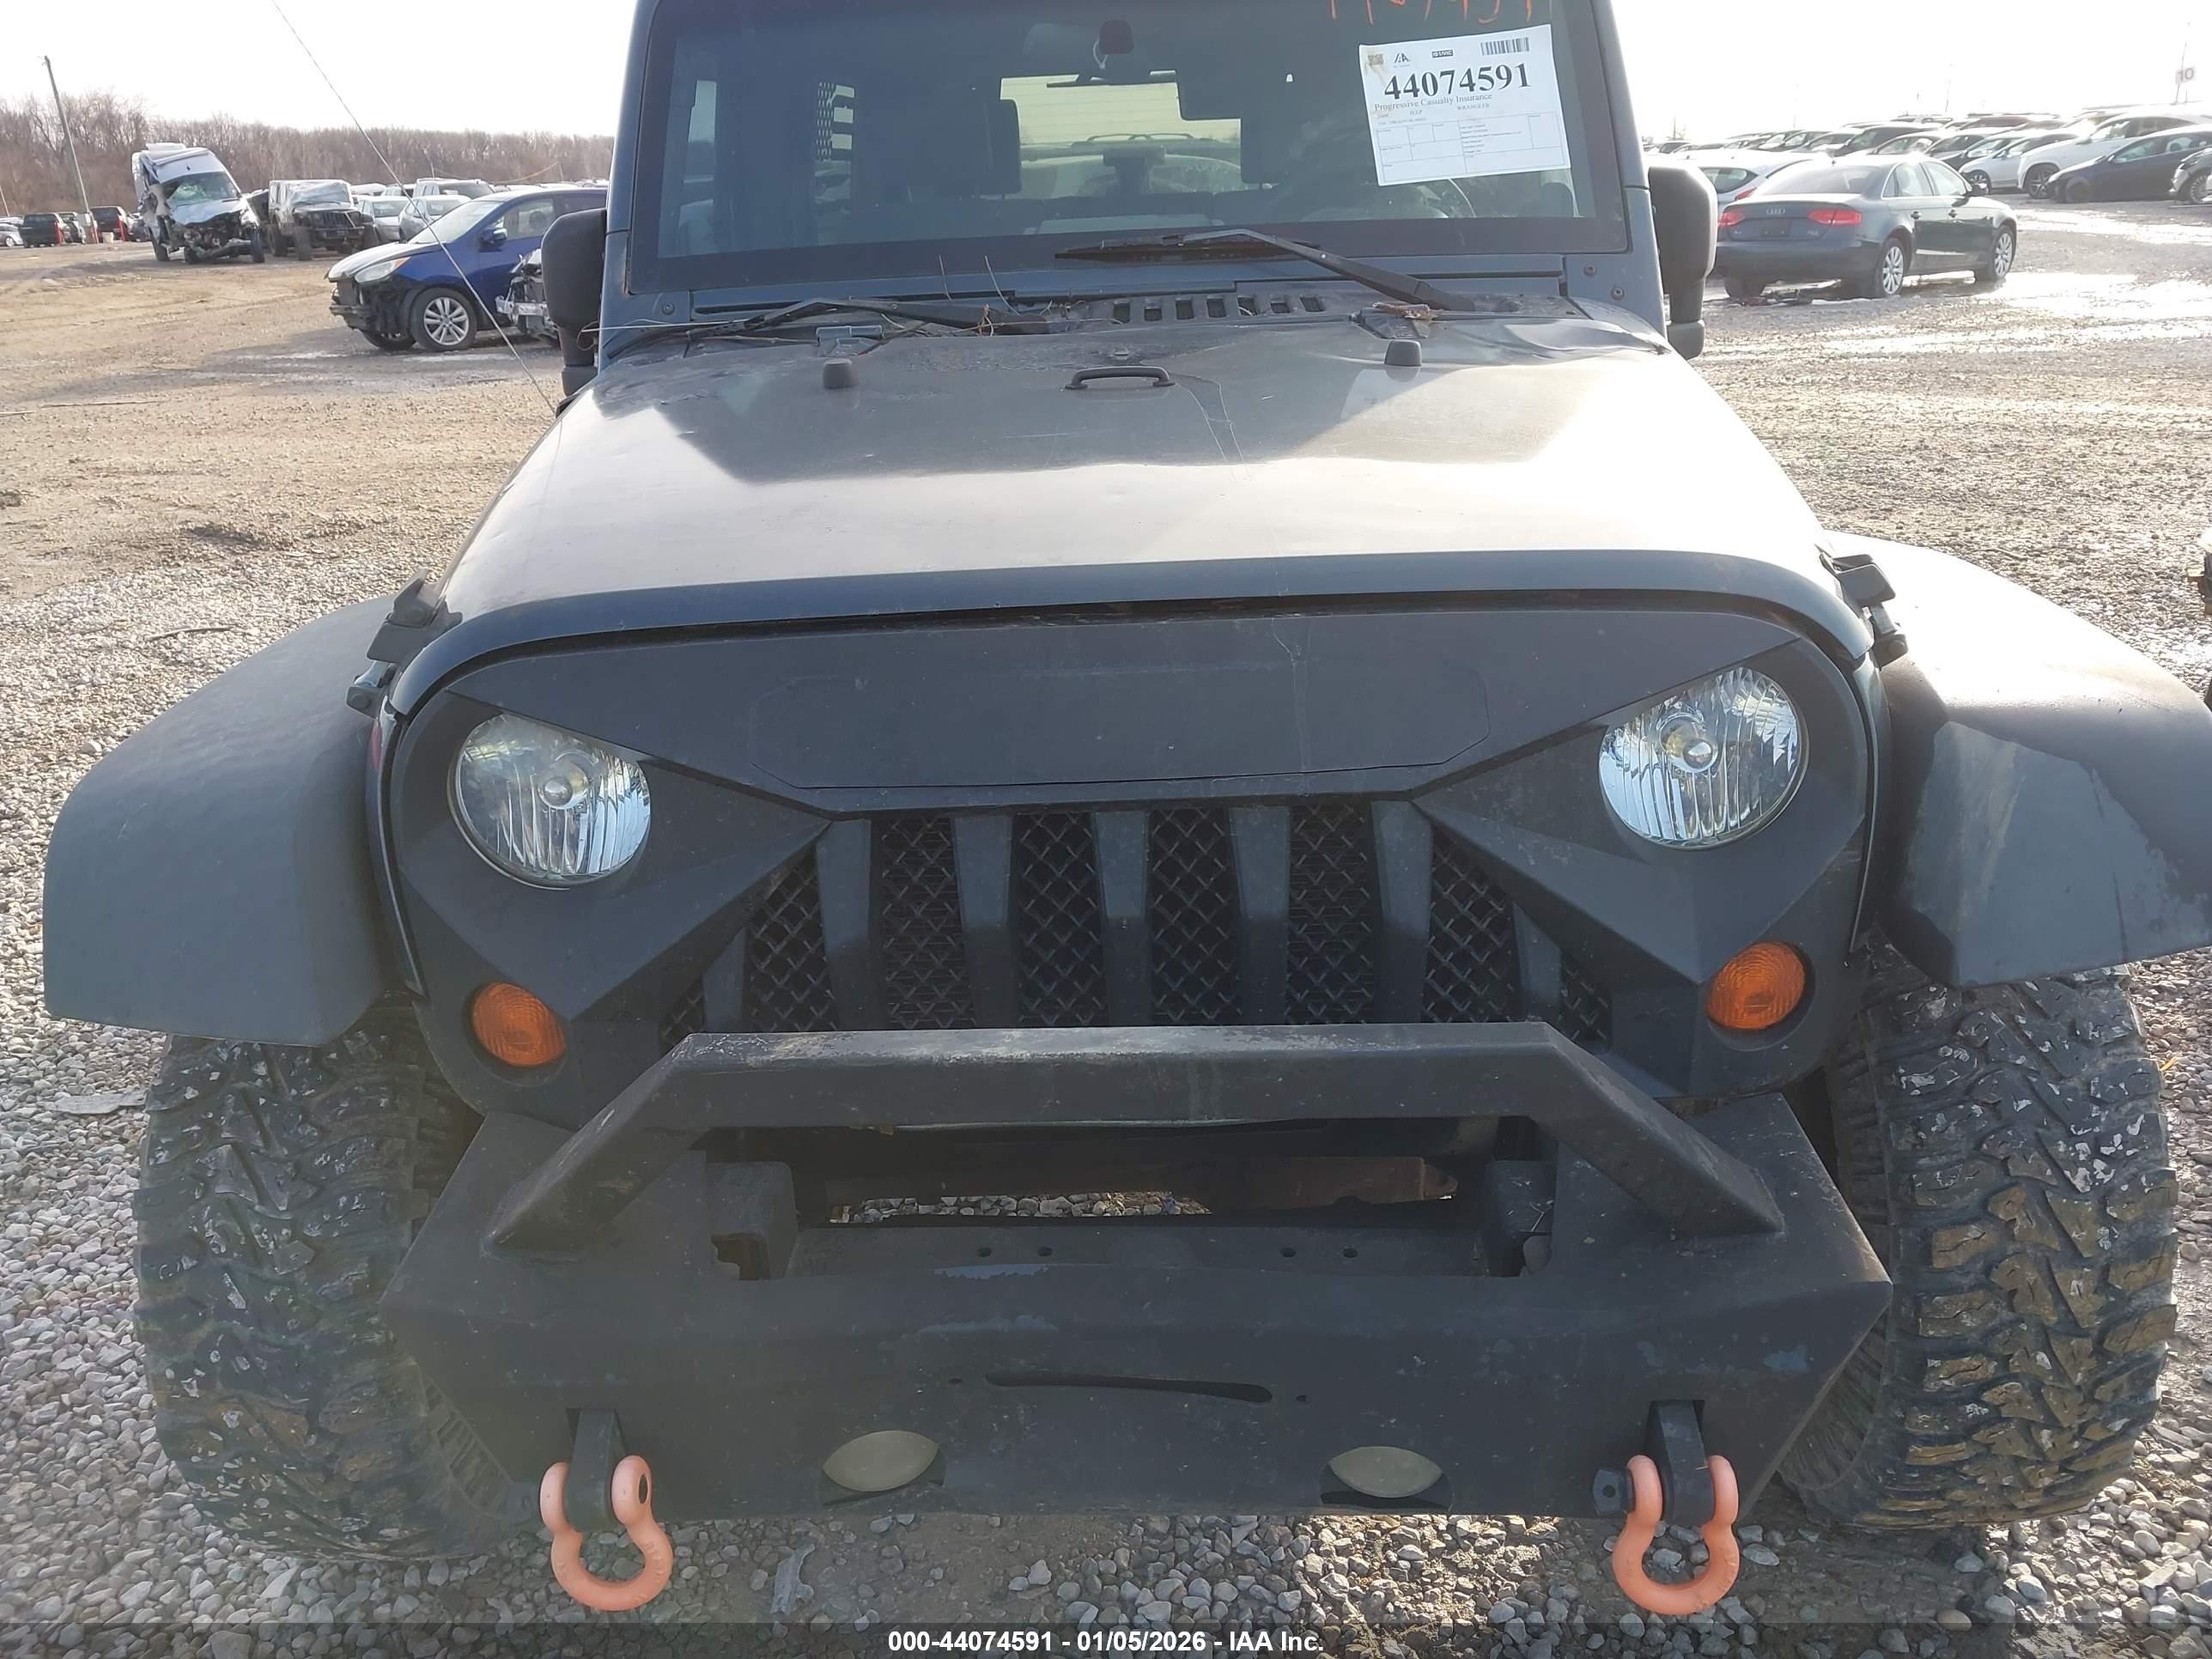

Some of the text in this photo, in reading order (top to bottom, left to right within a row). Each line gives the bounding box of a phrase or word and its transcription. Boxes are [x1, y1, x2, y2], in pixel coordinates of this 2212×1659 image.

[1384, 63, 1532, 100] 44074591
[2177, 68, 2195, 82] 10
[1374, 94, 1492, 111] Progressive Casualty Insurance
